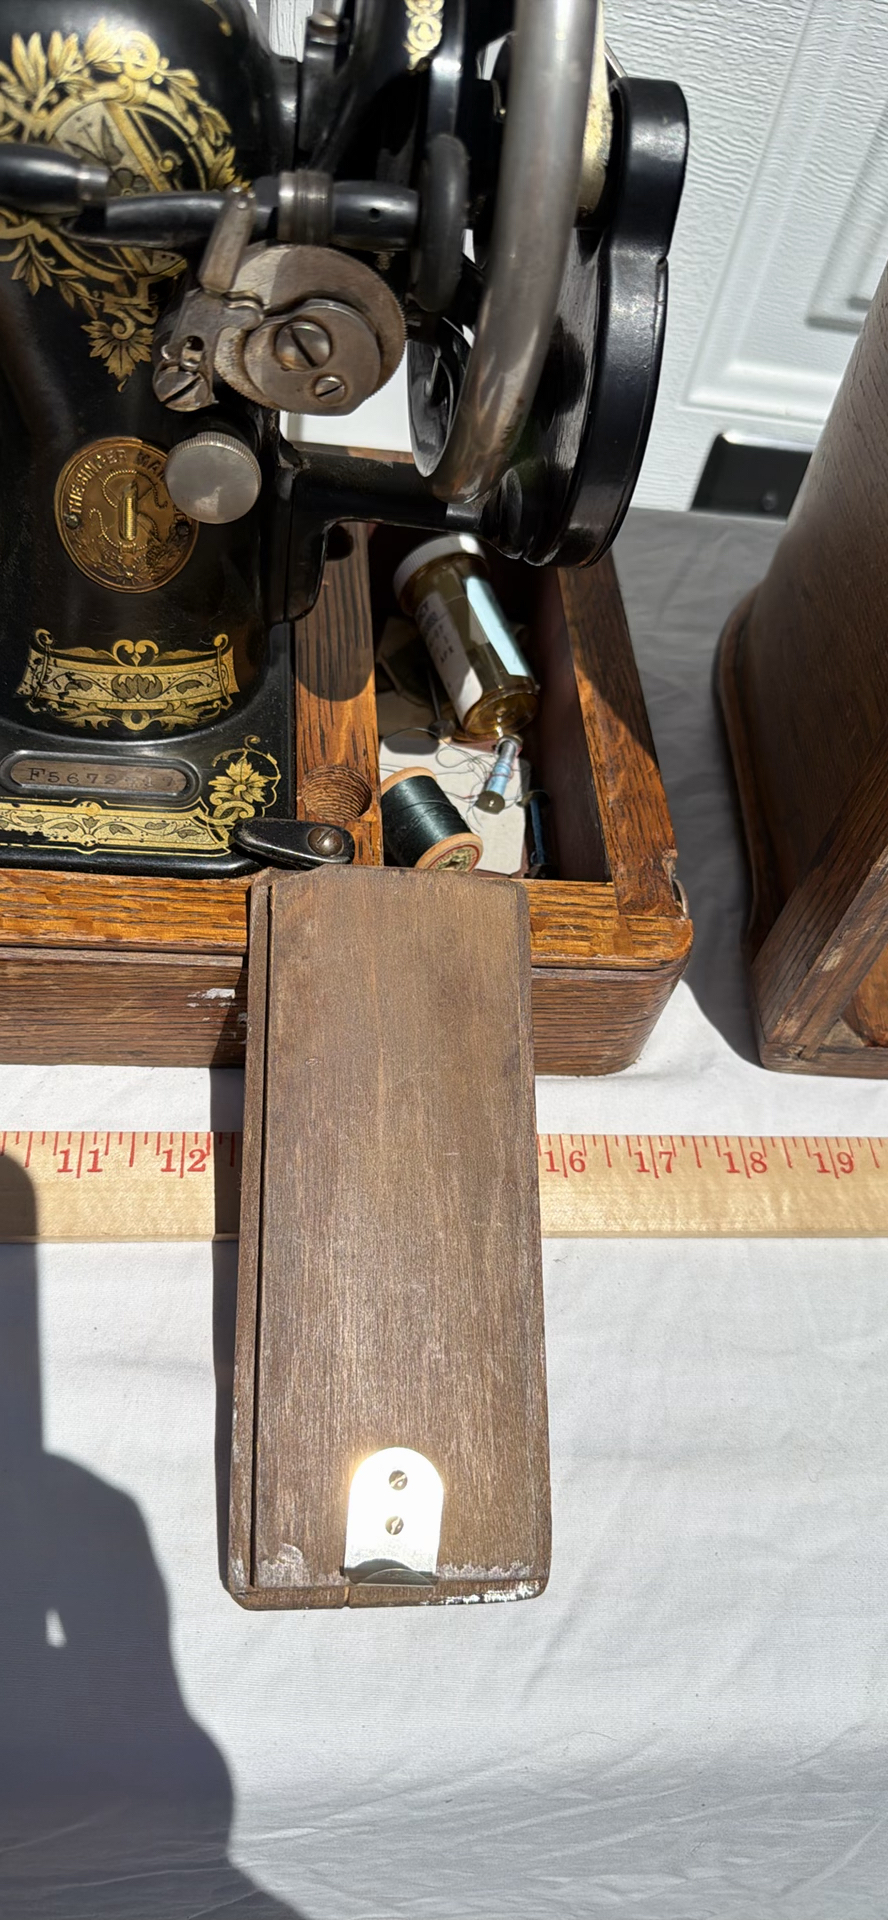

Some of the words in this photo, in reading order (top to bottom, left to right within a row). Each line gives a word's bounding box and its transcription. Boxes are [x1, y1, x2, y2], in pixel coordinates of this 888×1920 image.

[75, 449, 127, 486] SINGER
[68, 483, 86, 513] THE
[57, 1148, 103, 1173] 11
[160, 1148, 207, 1173] 12
[545, 1150, 587, 1174] 16
[636, 1150, 675, 1174] 17
[723, 1150, 768, 1175] 18
[813, 1150, 856, 1175] 19
